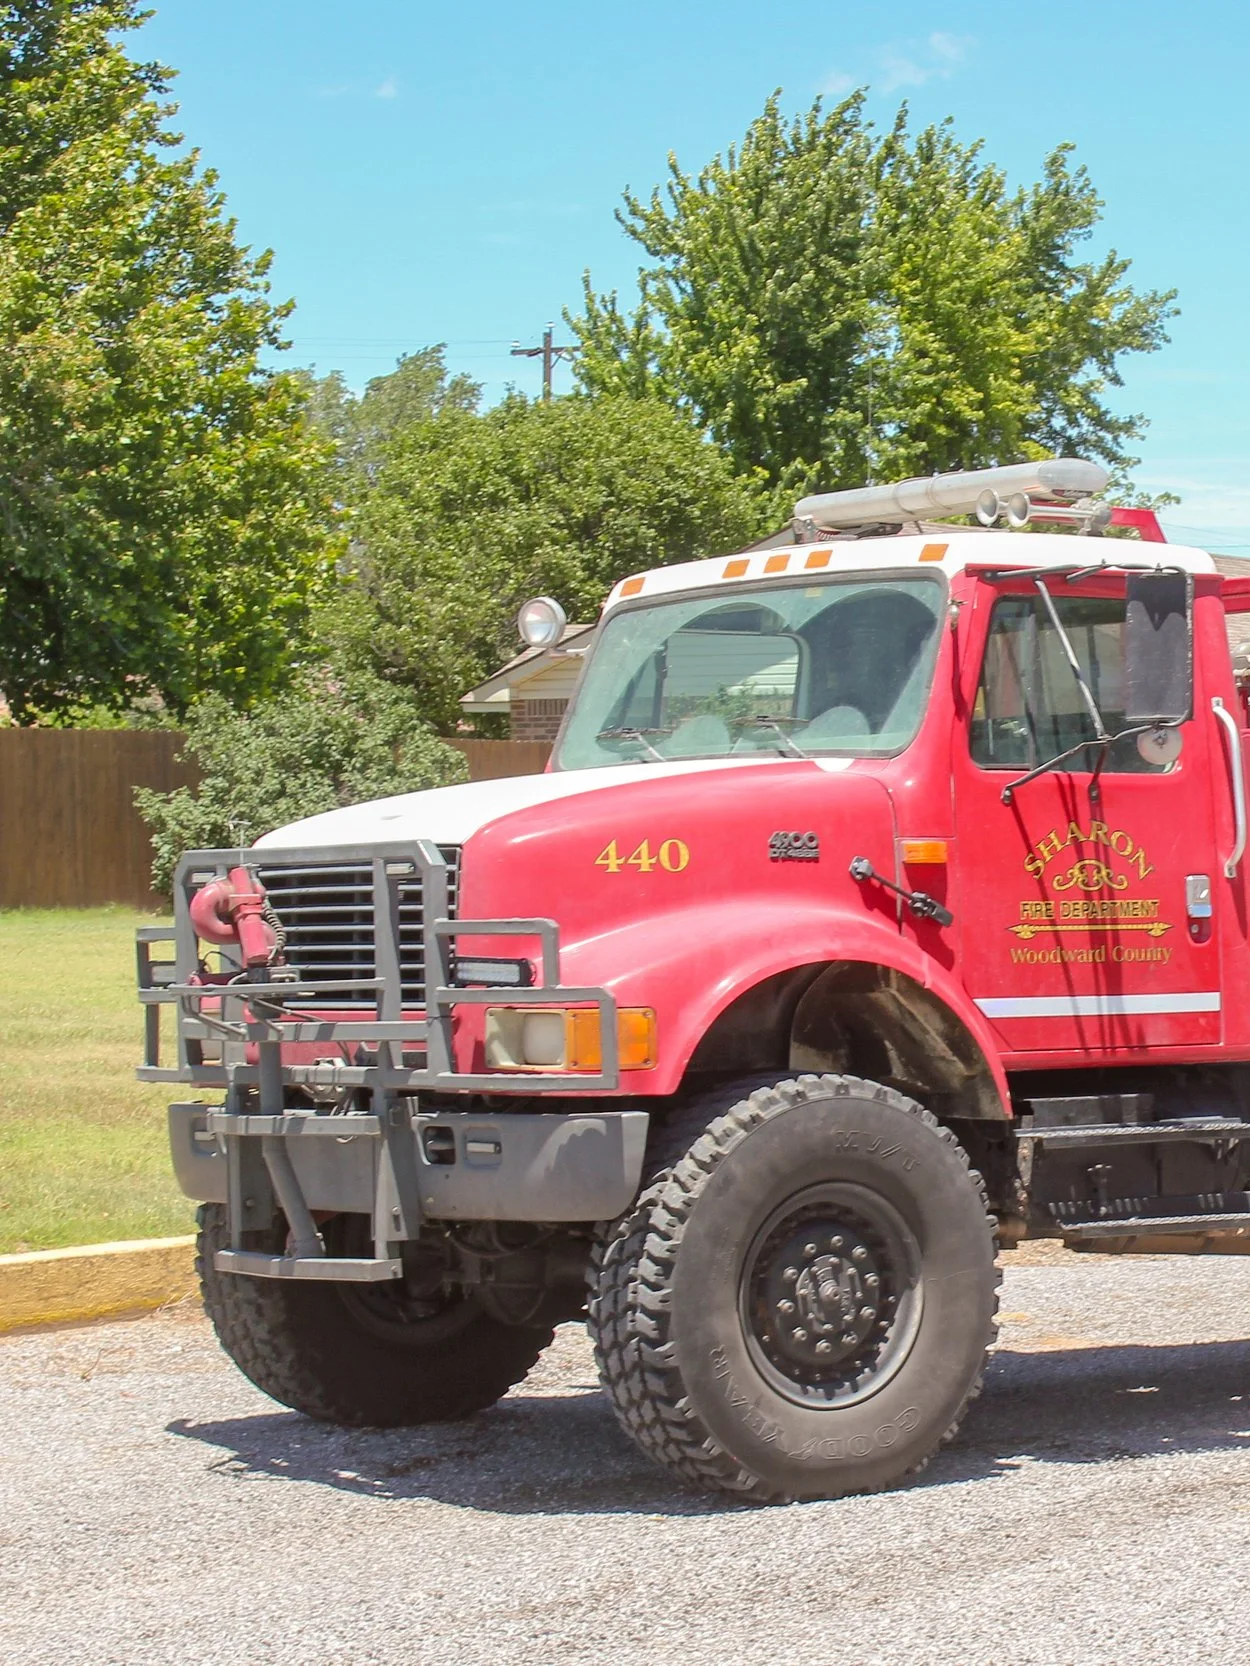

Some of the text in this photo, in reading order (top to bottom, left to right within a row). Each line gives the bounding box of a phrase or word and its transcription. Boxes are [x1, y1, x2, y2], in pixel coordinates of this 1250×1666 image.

[767, 831, 819, 849] 4900
[1023, 819, 1155, 880] SHARON
[593, 838, 690, 873] 440
[1019, 899, 1160, 920] FIRE DEPARTMENT
[1010, 946, 1173, 966] Woodward County
[709, 1344, 922, 1461] GOODYEAR
